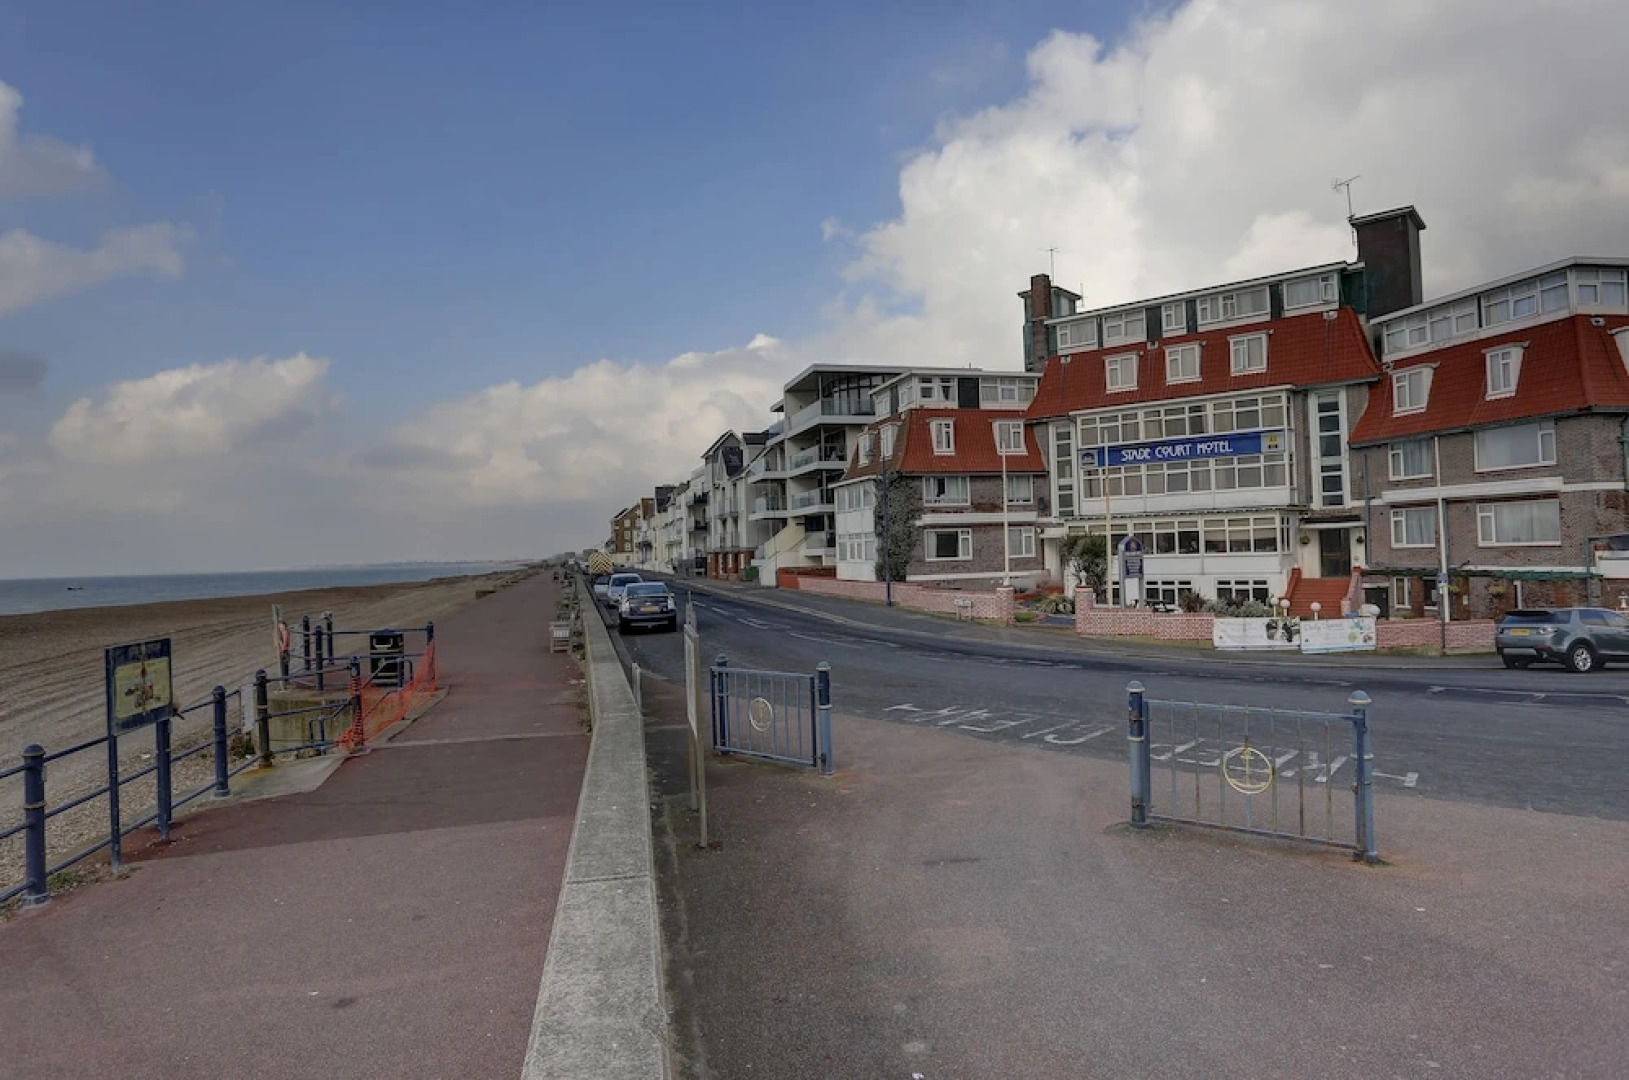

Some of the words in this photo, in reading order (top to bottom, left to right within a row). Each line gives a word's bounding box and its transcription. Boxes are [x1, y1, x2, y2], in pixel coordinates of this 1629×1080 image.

[1121, 447, 1151, 461] STADE
[1155, 444, 1191, 458] COURT
[1196, 440, 1233, 454] HOTEL
